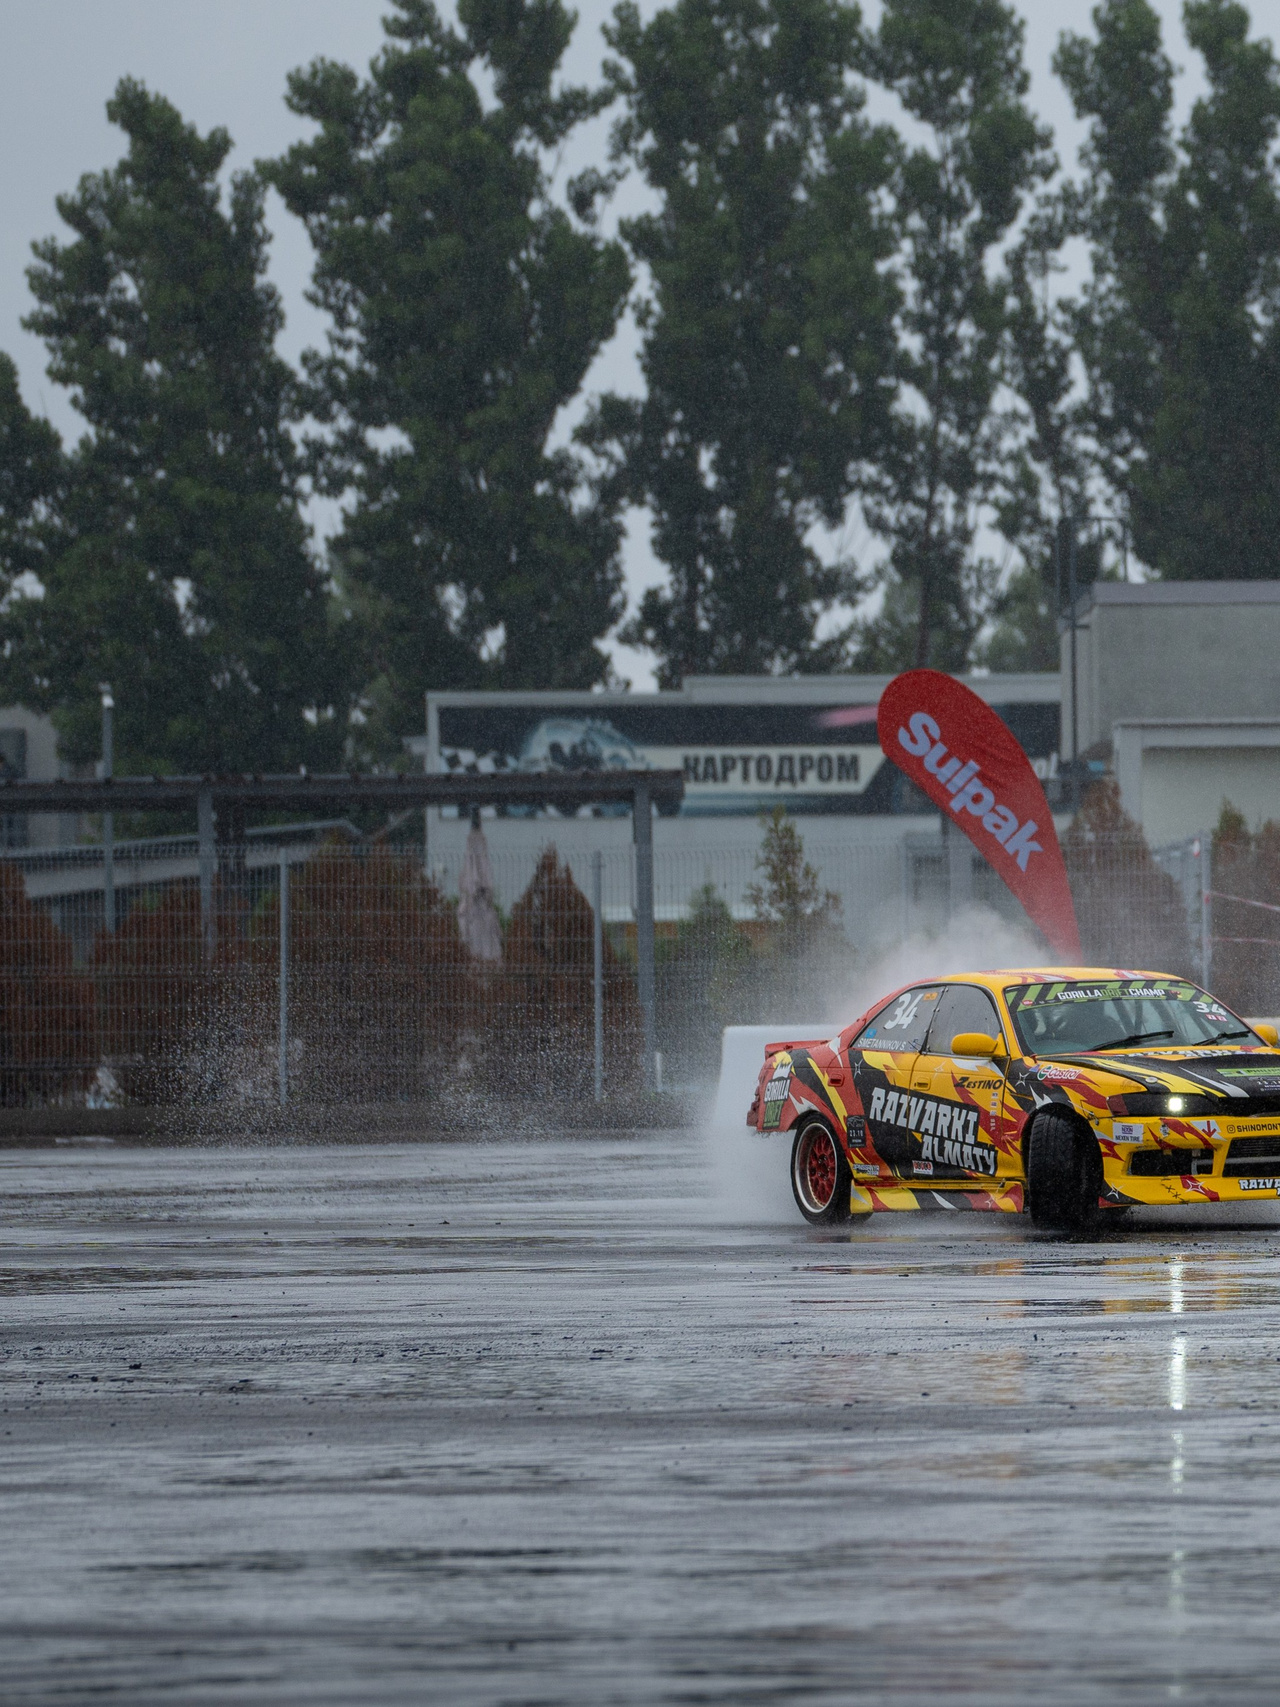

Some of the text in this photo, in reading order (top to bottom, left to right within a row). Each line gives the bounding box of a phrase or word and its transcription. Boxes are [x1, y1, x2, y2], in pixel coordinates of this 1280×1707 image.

[682, 754, 860, 787] КАРТОДРОМ
[898, 711, 1043, 872] Sulpak
[883, 993, 924, 1030] 34
[1193, 1001, 1227, 1016] 34
[955, 1076, 1003, 1090] ZESTINO
[1048, 1067, 1081, 1080] Castrol
[871, 1087, 978, 1145] RAZVARKI
[921, 1134, 996, 1175] ALMATY
[1115, 1134, 1128, 1142] NEXEN
